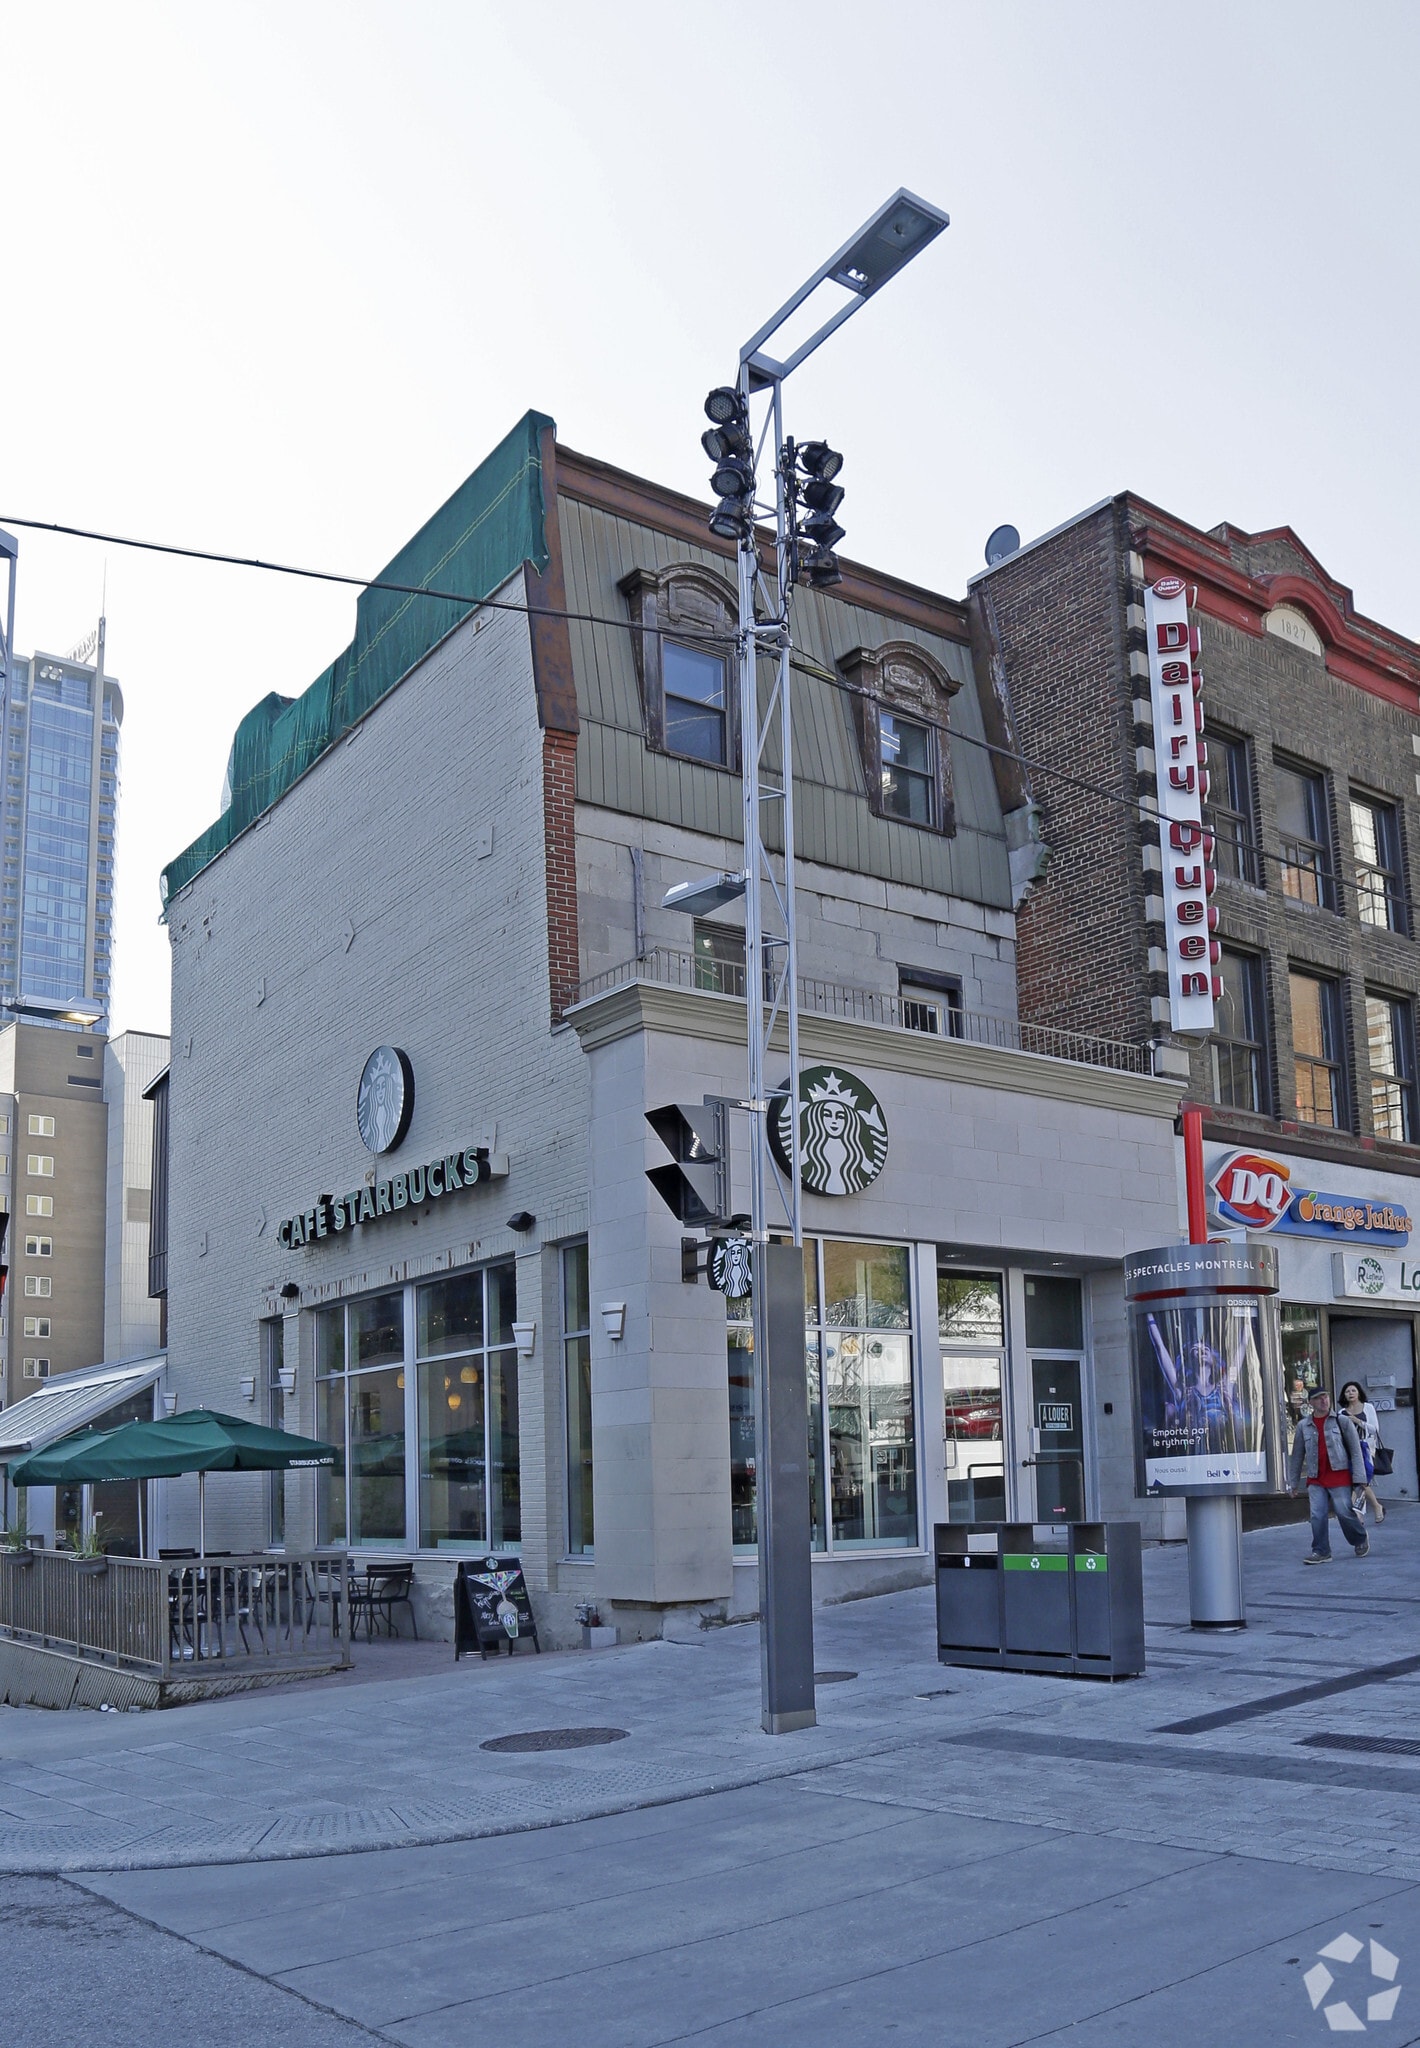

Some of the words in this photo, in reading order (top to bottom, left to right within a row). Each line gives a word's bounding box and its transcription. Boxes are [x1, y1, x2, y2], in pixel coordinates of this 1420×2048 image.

[1281, 618, 1306, 641] 1827
[1156, 622, 1195, 795] Dairy
[1169, 820, 1209, 997] Queen
[333, 1146, 479, 1231] STARBUCKS
[1229, 1168, 1281, 1214] DQ
[1299, 1197, 1364, 1230] Orange
[1365, 1204, 1412, 1232] Julius
[1133, 1261, 1191, 1278] SPECTACLES
[1195, 1258, 1254, 1270] MONTRÉAL
[1048, 1407, 1069, 1421] LOUER
[1153, 1426, 1189, 1438] Emporté
[1153, 1439, 1160, 1447] le
[1161, 1437, 1195, 1449] rythme
[1206, 1469, 1220, 1478] Bell
